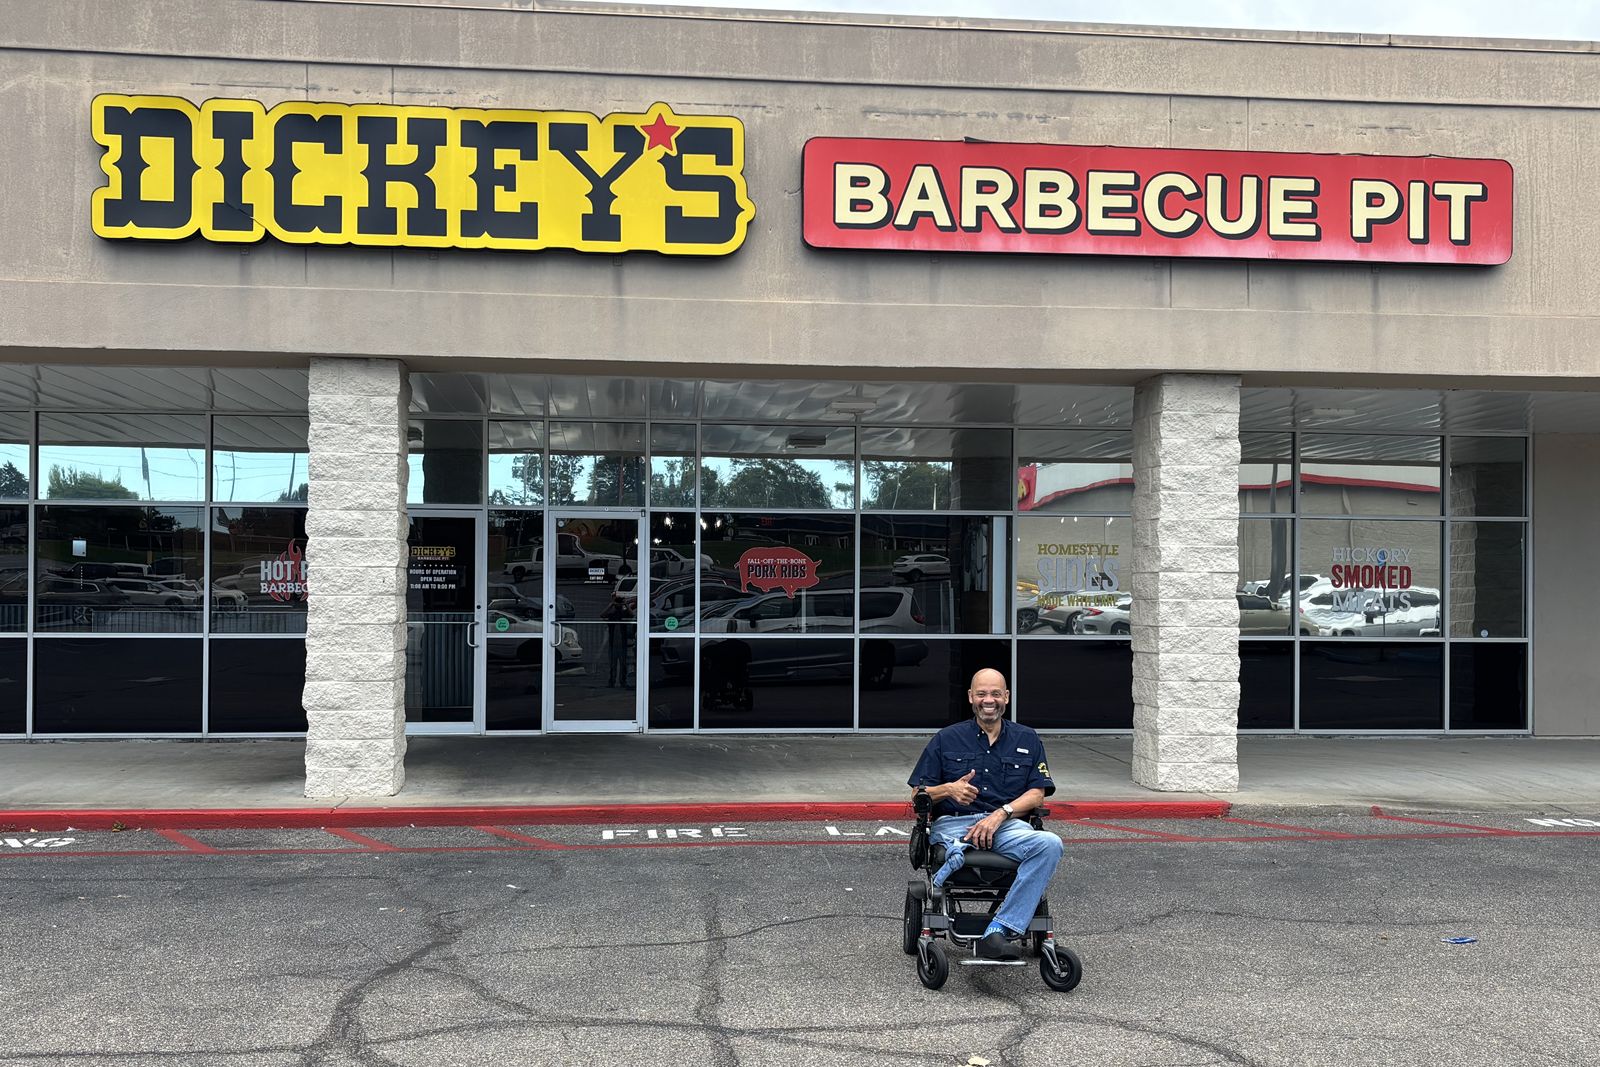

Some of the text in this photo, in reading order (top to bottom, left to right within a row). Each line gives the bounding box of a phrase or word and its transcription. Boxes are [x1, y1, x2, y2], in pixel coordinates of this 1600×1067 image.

[104, 105, 745, 245] DICKEY'S
[833, 162, 1488, 246] BARBECUE PIT
[1037, 544, 1120, 556] HOMESTYLE
[1332, 547, 1413, 562] HICKORY
[260, 560, 295, 581] HOT
[747, 565, 808, 579] PORK RIBS
[1037, 556, 1121, 592] SIDES
[1331, 564, 1412, 589] SMOKED
[1331, 591, 1412, 613] MEATS
[602, 825, 748, 840] FIRE
